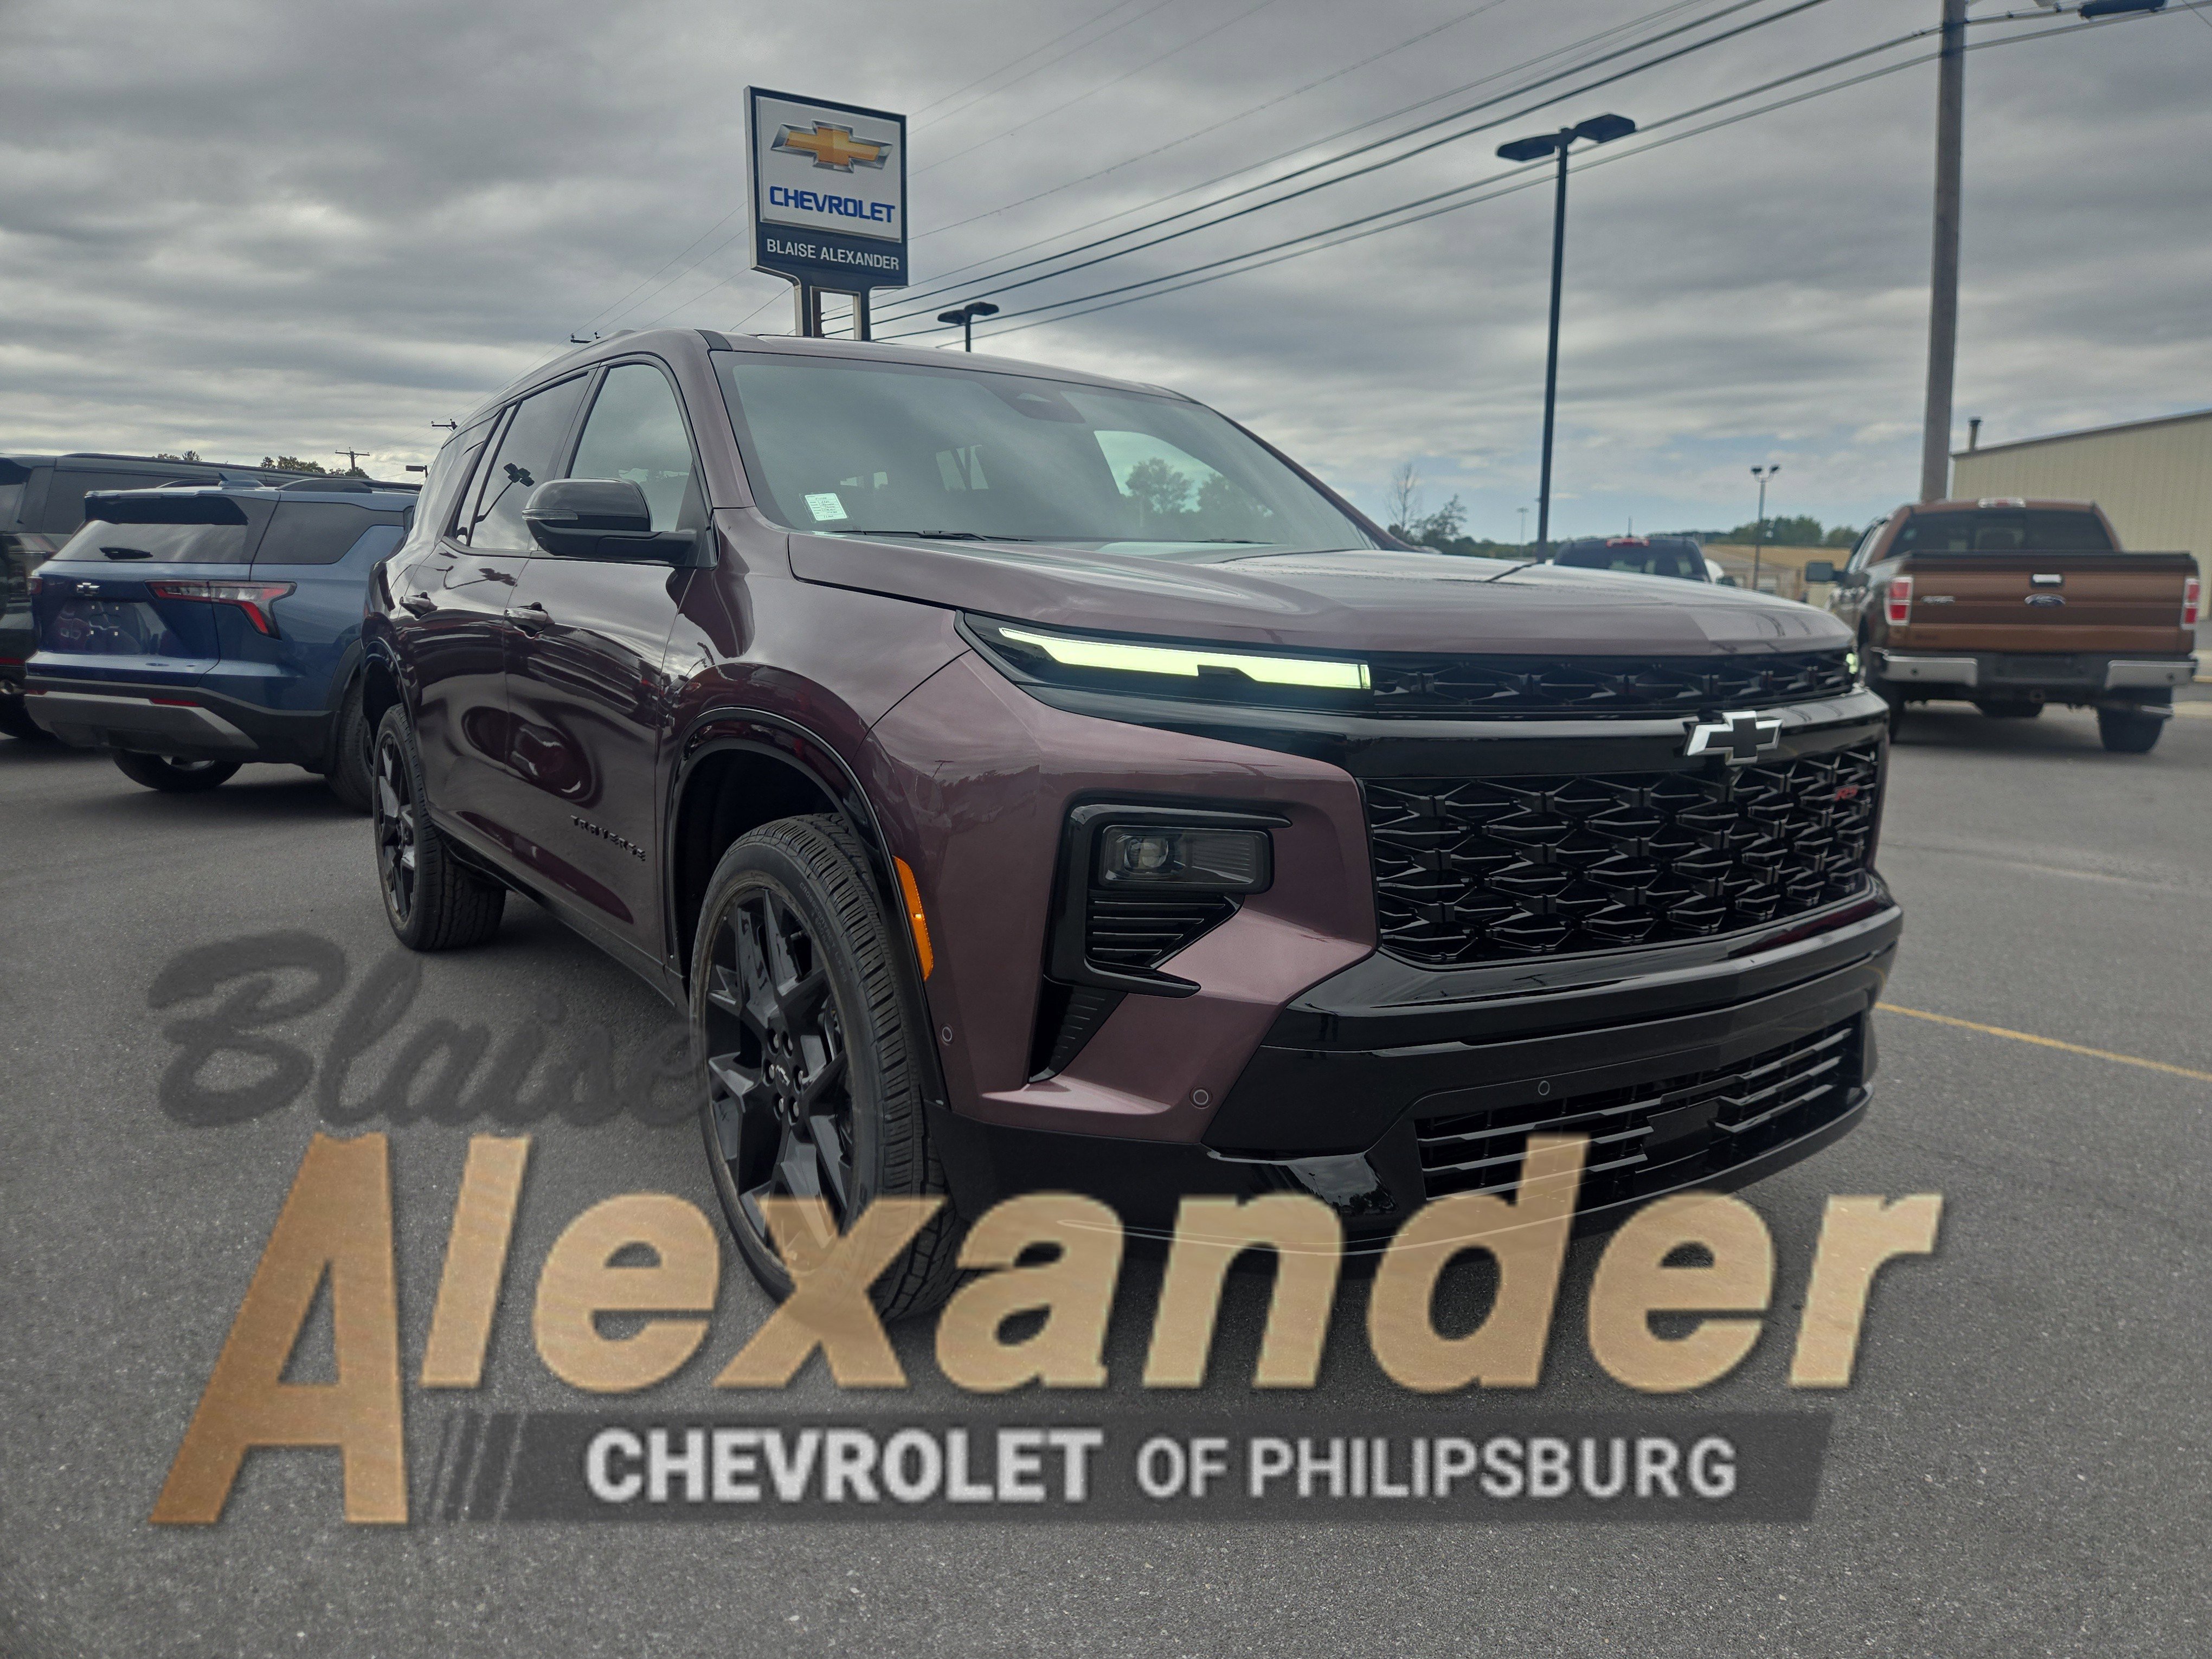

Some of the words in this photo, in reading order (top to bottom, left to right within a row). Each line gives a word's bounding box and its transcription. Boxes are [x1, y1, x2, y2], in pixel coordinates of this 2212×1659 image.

[769, 185, 896, 223] CHEVROLET
[766, 239, 816, 259] BLAISE
[820, 247, 899, 271] ALEXANDER
